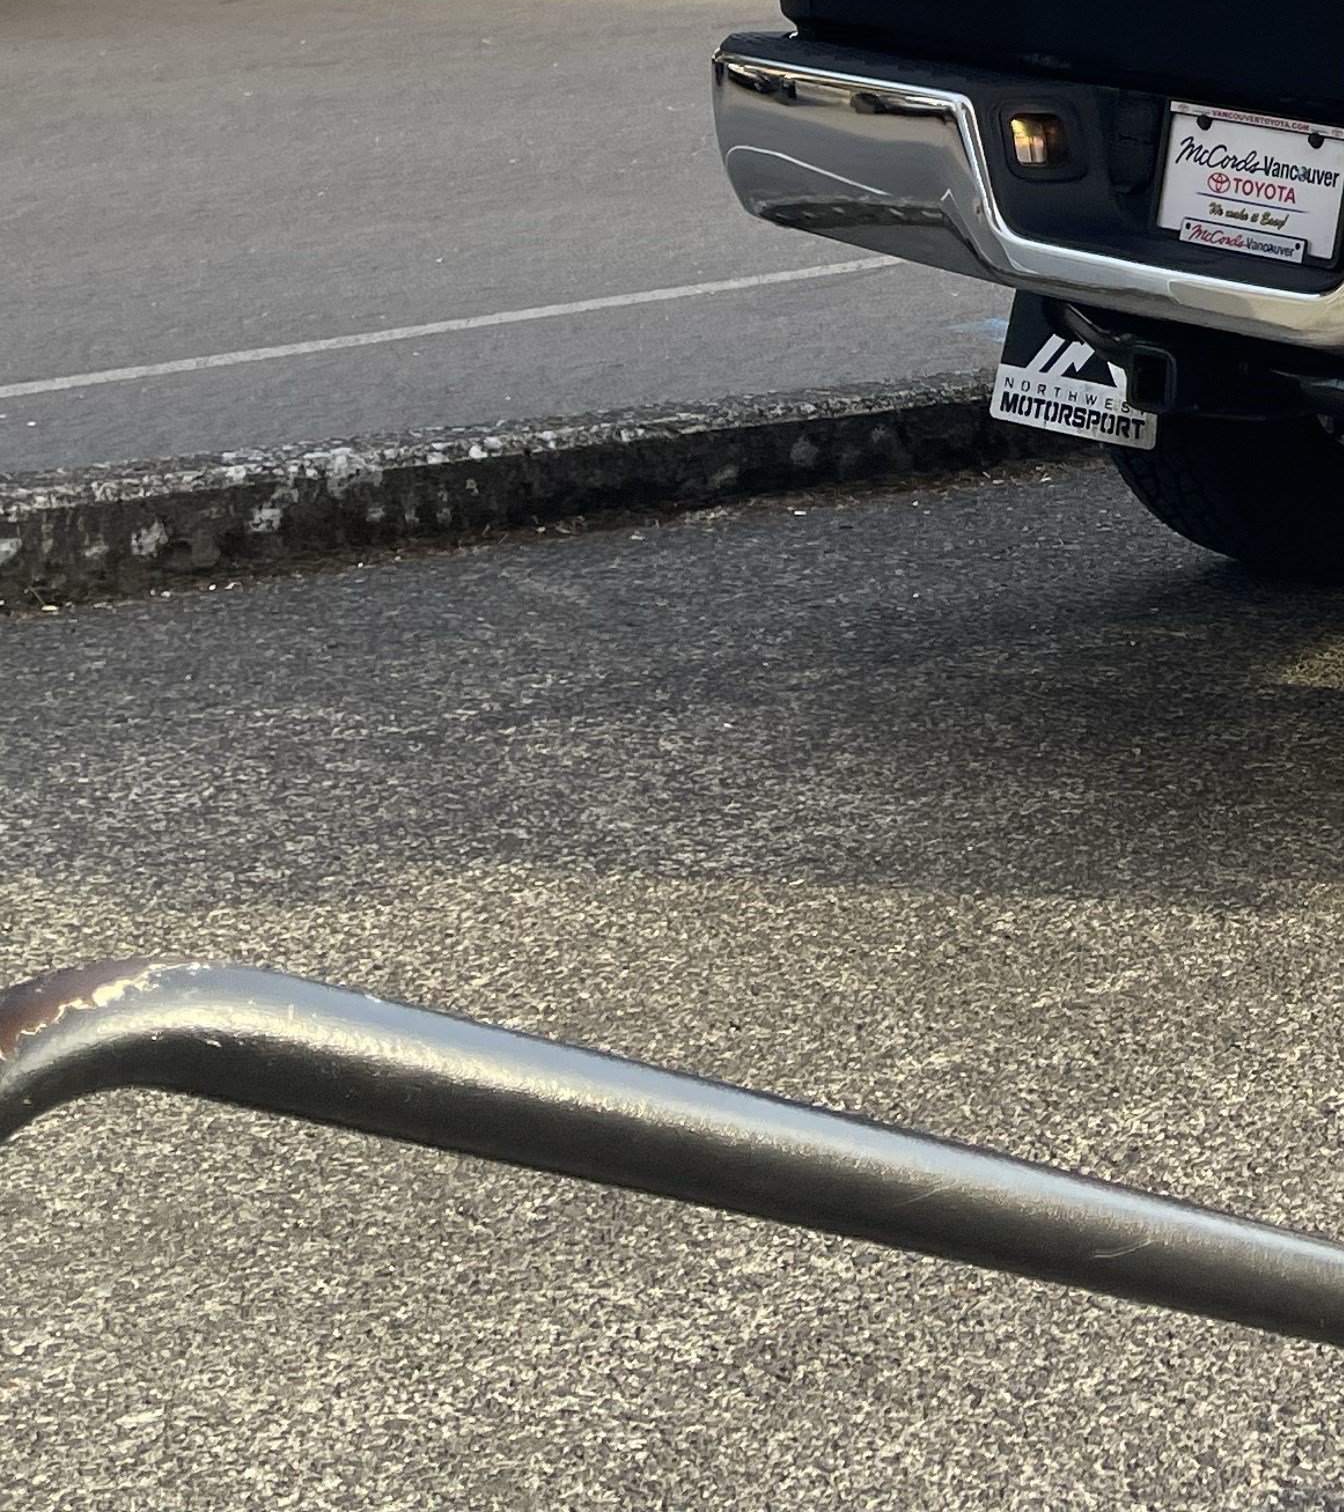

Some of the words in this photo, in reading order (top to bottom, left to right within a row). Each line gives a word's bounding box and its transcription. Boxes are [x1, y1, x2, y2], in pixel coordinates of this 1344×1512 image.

[1233, 177, 1296, 204] TOYOTA
[1000, 391, 1145, 440] MOTORSPORT
[1004, 376, 1145, 416] NORTHWES
